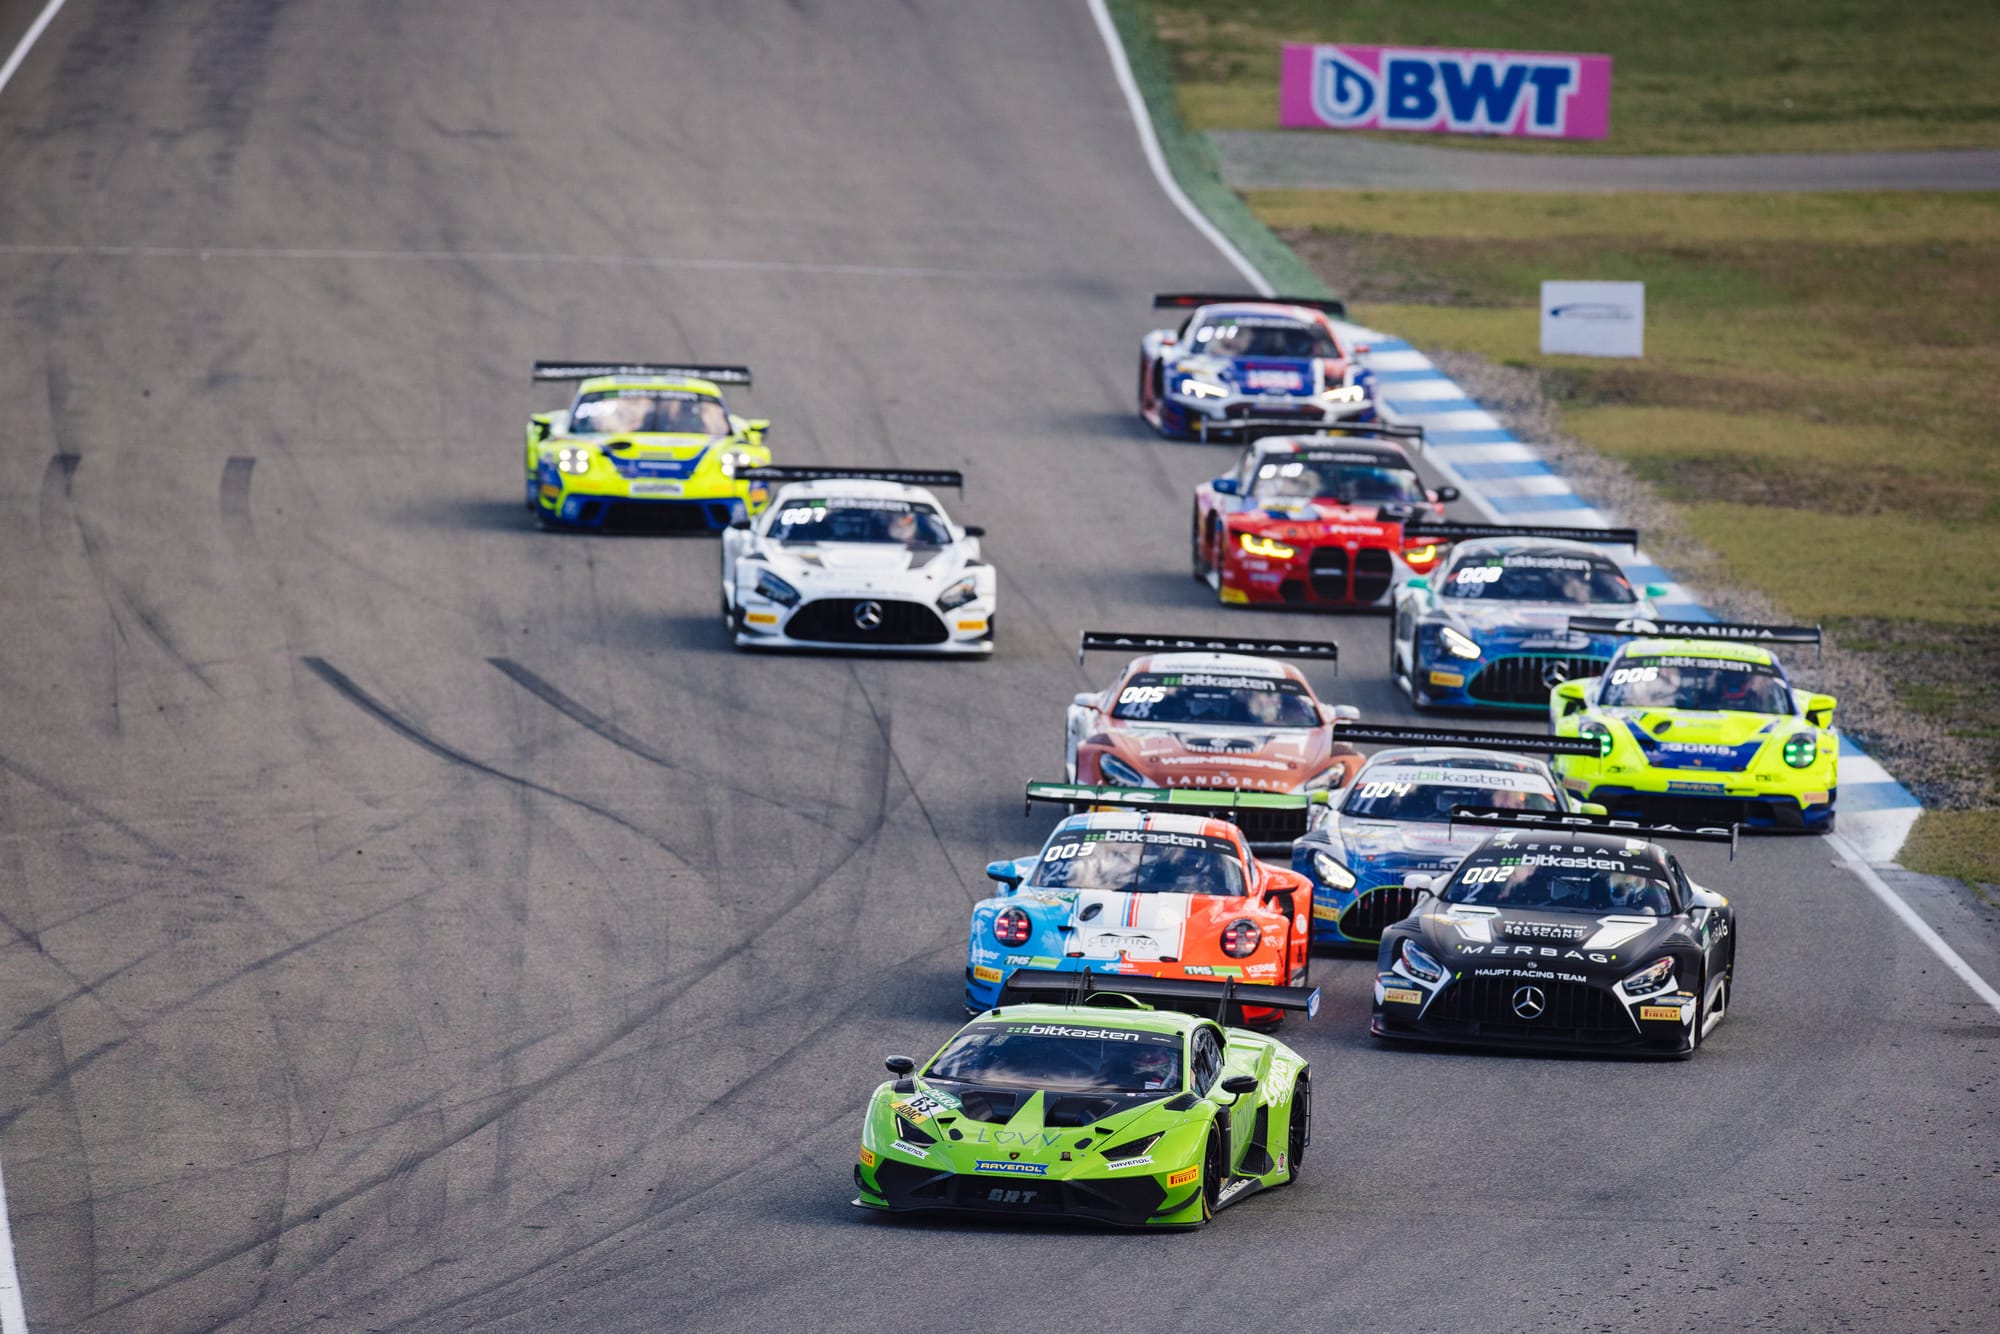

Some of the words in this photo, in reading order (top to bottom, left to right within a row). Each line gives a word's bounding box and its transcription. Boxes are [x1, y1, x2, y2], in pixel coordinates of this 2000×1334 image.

[1382, 54, 1578, 131] BWT
[1664, 623, 1774, 640] KAARISMA
[1660, 656, 1752, 673] bitkasten
[1180, 675, 1276, 691] bitkasten
[1611, 666, 1659, 685] 006
[1118, 687, 1168, 704] 005
[1346, 728, 1394, 739] DATA
[1399, 731, 1469, 742] DRIVES
[1474, 735, 1594, 750] INNOVATION
[1416, 769, 1516, 787] bitkasten
[1040, 787, 1156, 804] TMS
[1360, 783, 1413, 798] 004
[1459, 811, 1731, 835] MERBAG
[1105, 831, 1206, 849] bitkasten
[1044, 842, 1097, 862] 003
[1503, 843, 1633, 857] MERBAG
[1044, 862, 1074, 881] 25
[1522, 855, 1625, 872] bitkasten
[1462, 866, 1514, 885] 002
[1088, 937, 1159, 946] CERTINA
[1007, 956, 1031, 966] TMS
[1462, 946, 1608, 963] MERBAG
[1187, 966, 1212, 976] TMS
[1475, 968, 1511, 978] HAUPT
[1513, 970, 1554, 980] RACING
[1557, 973, 1587, 983] TEAM
[1645, 1008, 1678, 1018] PIRELLI
[1029, 1025, 1139, 1042] bitkasten
[911, 1096, 938, 1112] 63
[928, 1089, 960, 1109] DEKRA
[896, 1104, 922, 1120] ADAC
[895, 1142, 925, 1157] RAVENOL
[979, 1162, 1045, 1173] RAVENOL
[1110, 1158, 1150, 1170] RAVENOL
[1170, 1168, 1197, 1185] PIRELLI
[988, 1188, 1038, 1204] GRT
